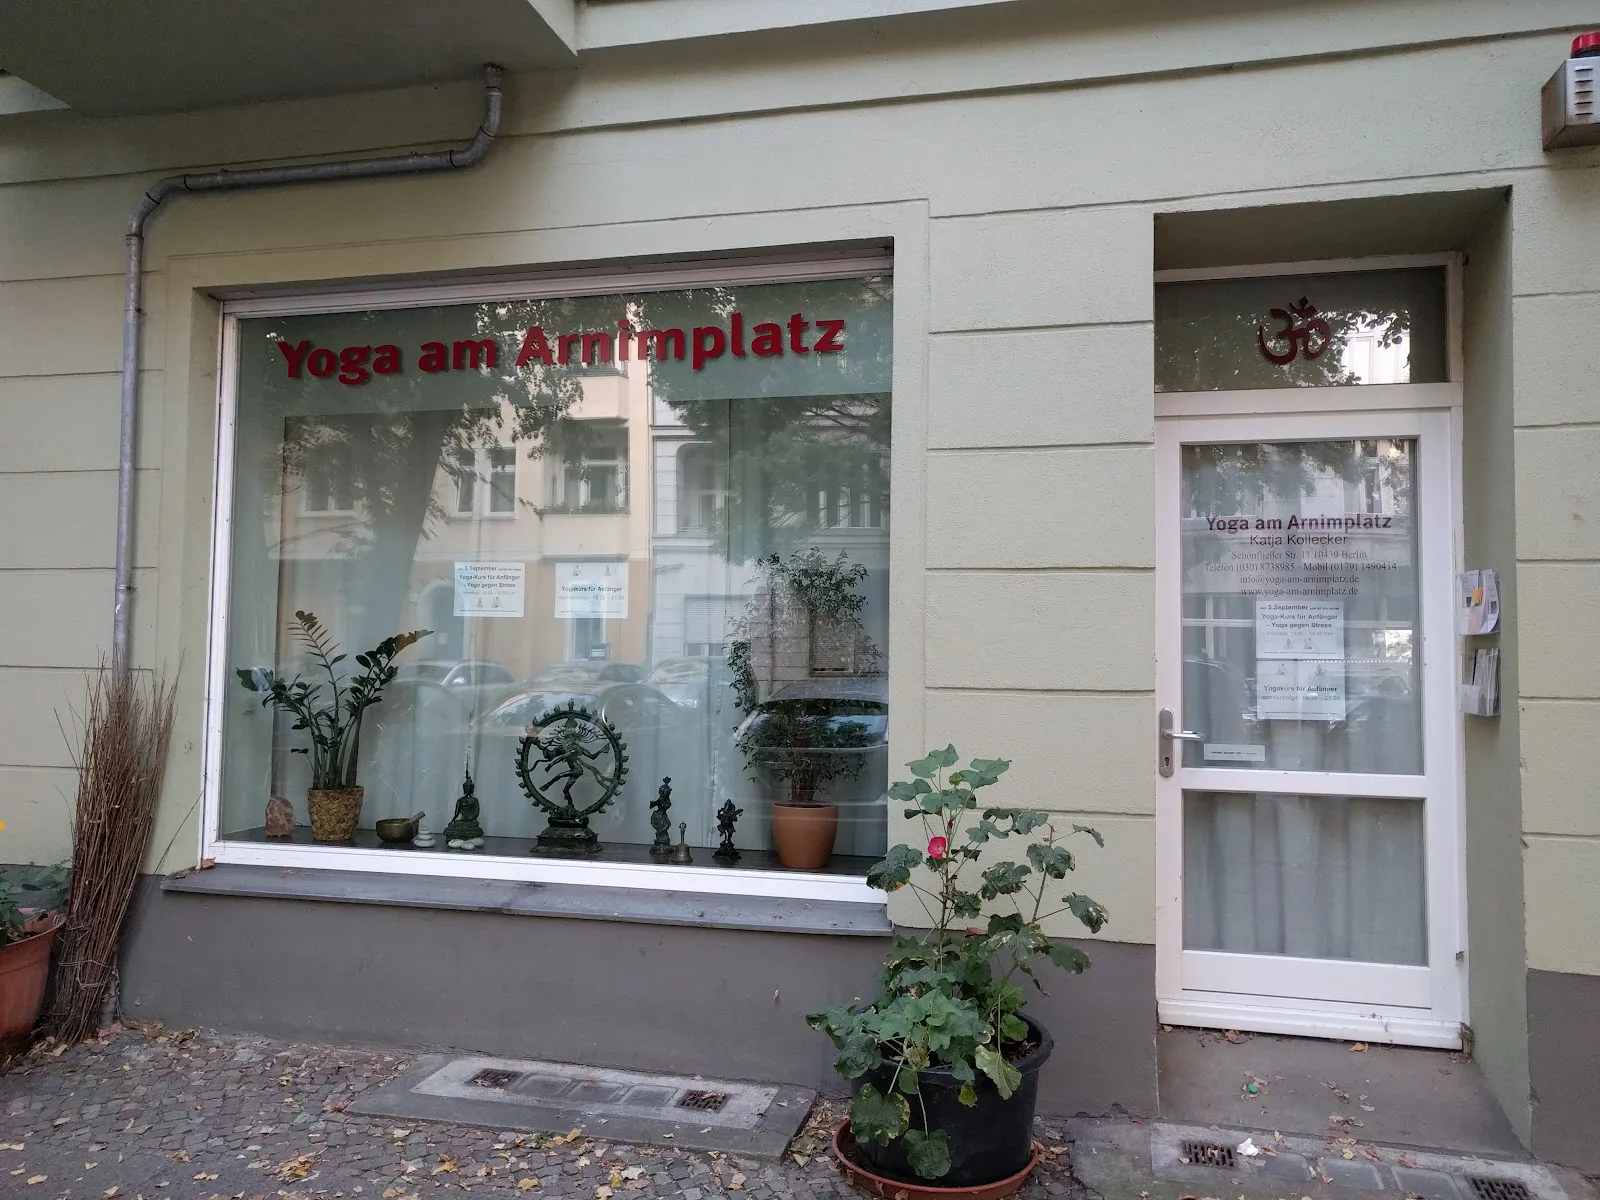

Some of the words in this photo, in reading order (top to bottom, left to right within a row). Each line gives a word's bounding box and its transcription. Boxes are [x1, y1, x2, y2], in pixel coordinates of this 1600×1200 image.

[278, 339, 402, 385] Yoga
[418, 335, 496, 373] am
[516, 312, 846, 370] Arnimplatz
[1206, 516, 1249, 534] Yoga
[1255, 518, 1282, 530] am
[1287, 513, 1392, 533] Arnimplatz
[1250, 534, 1282, 548] Katja
[1287, 534, 1348, 545] Kollecker
[1285, 551, 1299, 560] Str.
[1341, 550, 1367, 559] Berlin
[1205, 563, 1234, 572] Telefon
[1236, 562, 1258, 572] (030)
[1260, 562, 1295, 572] 8738985
[1303, 562, 1328, 571] Mobil
[1330, 562, 1358, 572] (0179)
[1361, 562, 1397, 571] 1490414
[1240, 574, 1360, 586] info@yoga-am-arnimplatz.de
[1240, 586, 1359, 598] www.yoga-am-arnimplatz.de
[1264, 685, 1295, 693] Yogakurs
